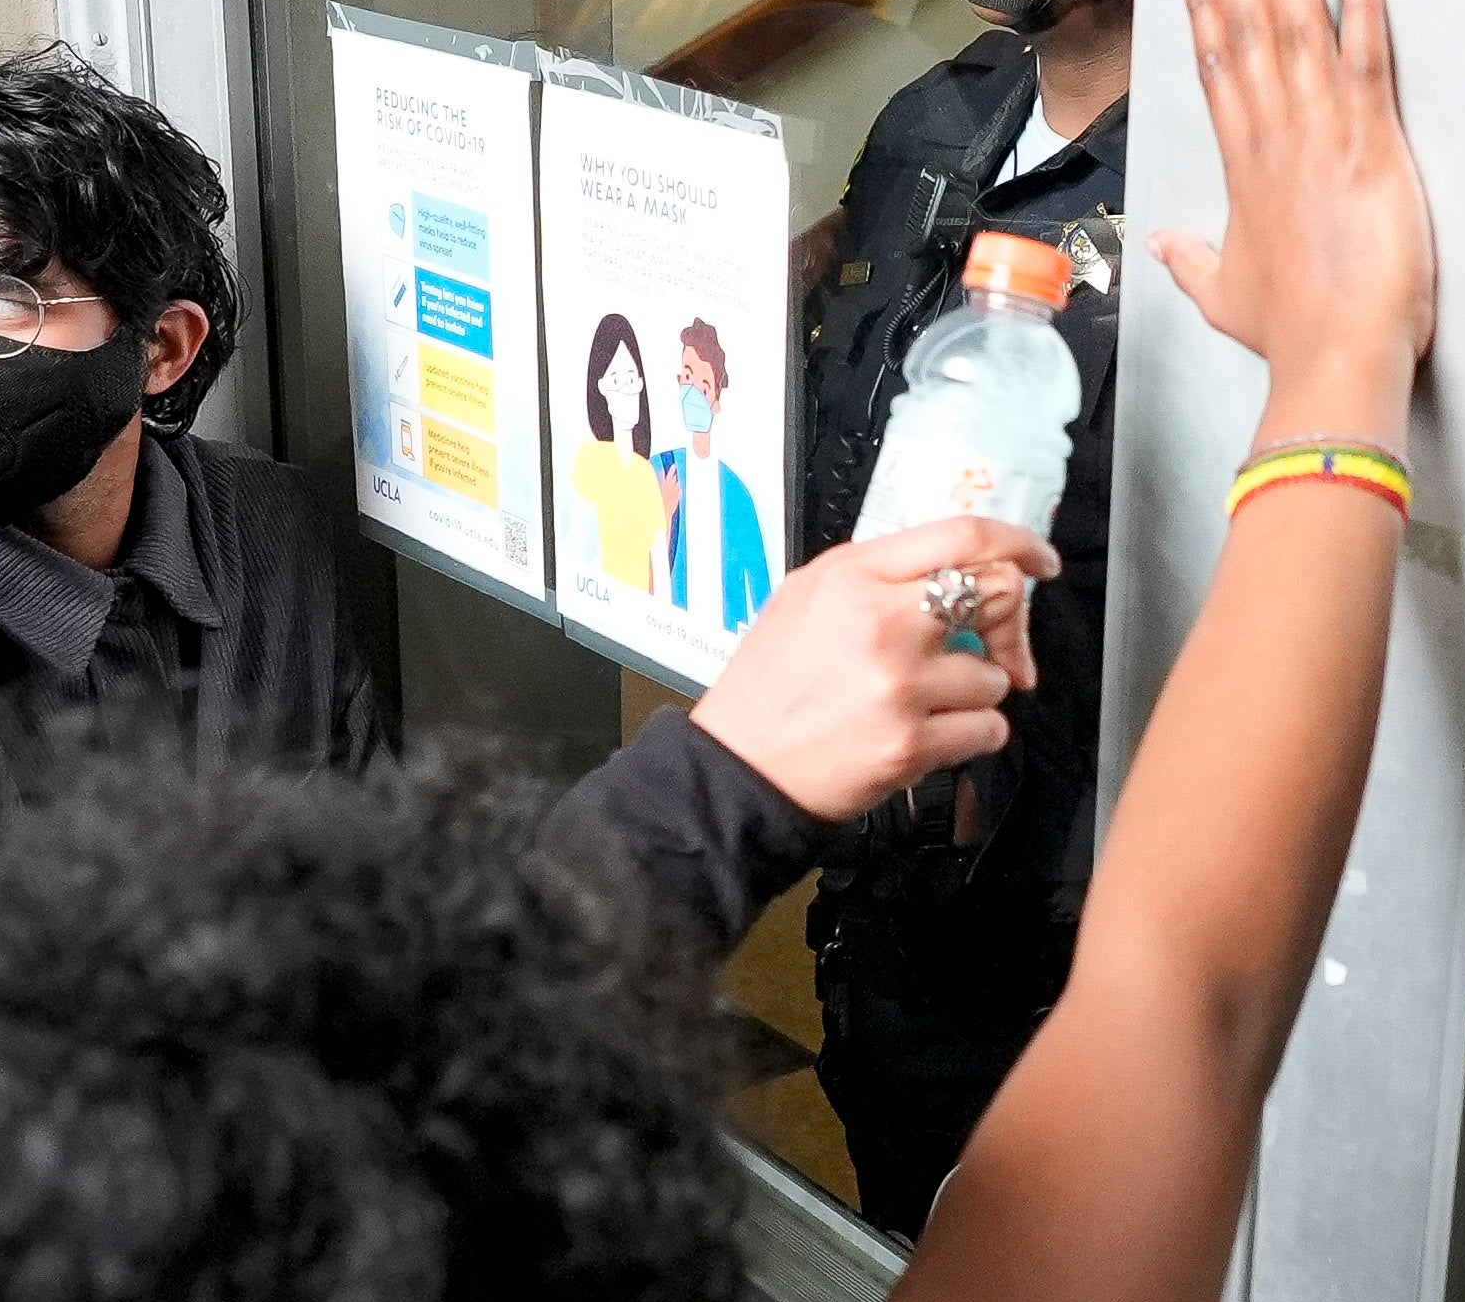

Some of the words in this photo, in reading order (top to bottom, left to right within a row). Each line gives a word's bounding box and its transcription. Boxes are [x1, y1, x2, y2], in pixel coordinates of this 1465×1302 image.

[376, 87, 438, 119] REDUCING
[444, 105, 466, 126] THE
[377, 110, 401, 131] RISK
[408, 118, 421, 137] OF
[427, 123, 484, 155] COVID-19
[580, 153, 614, 179] WHY
[621, 164, 650, 189] YOU
[658, 174, 717, 209] SHOULD
[581, 177, 621, 206] WEAR
[627, 191, 635, 210] A
[644, 196, 686, 225] MASK
[371, 474, 402, 506] UCLA
[576, 572, 610, 605] UCLA
